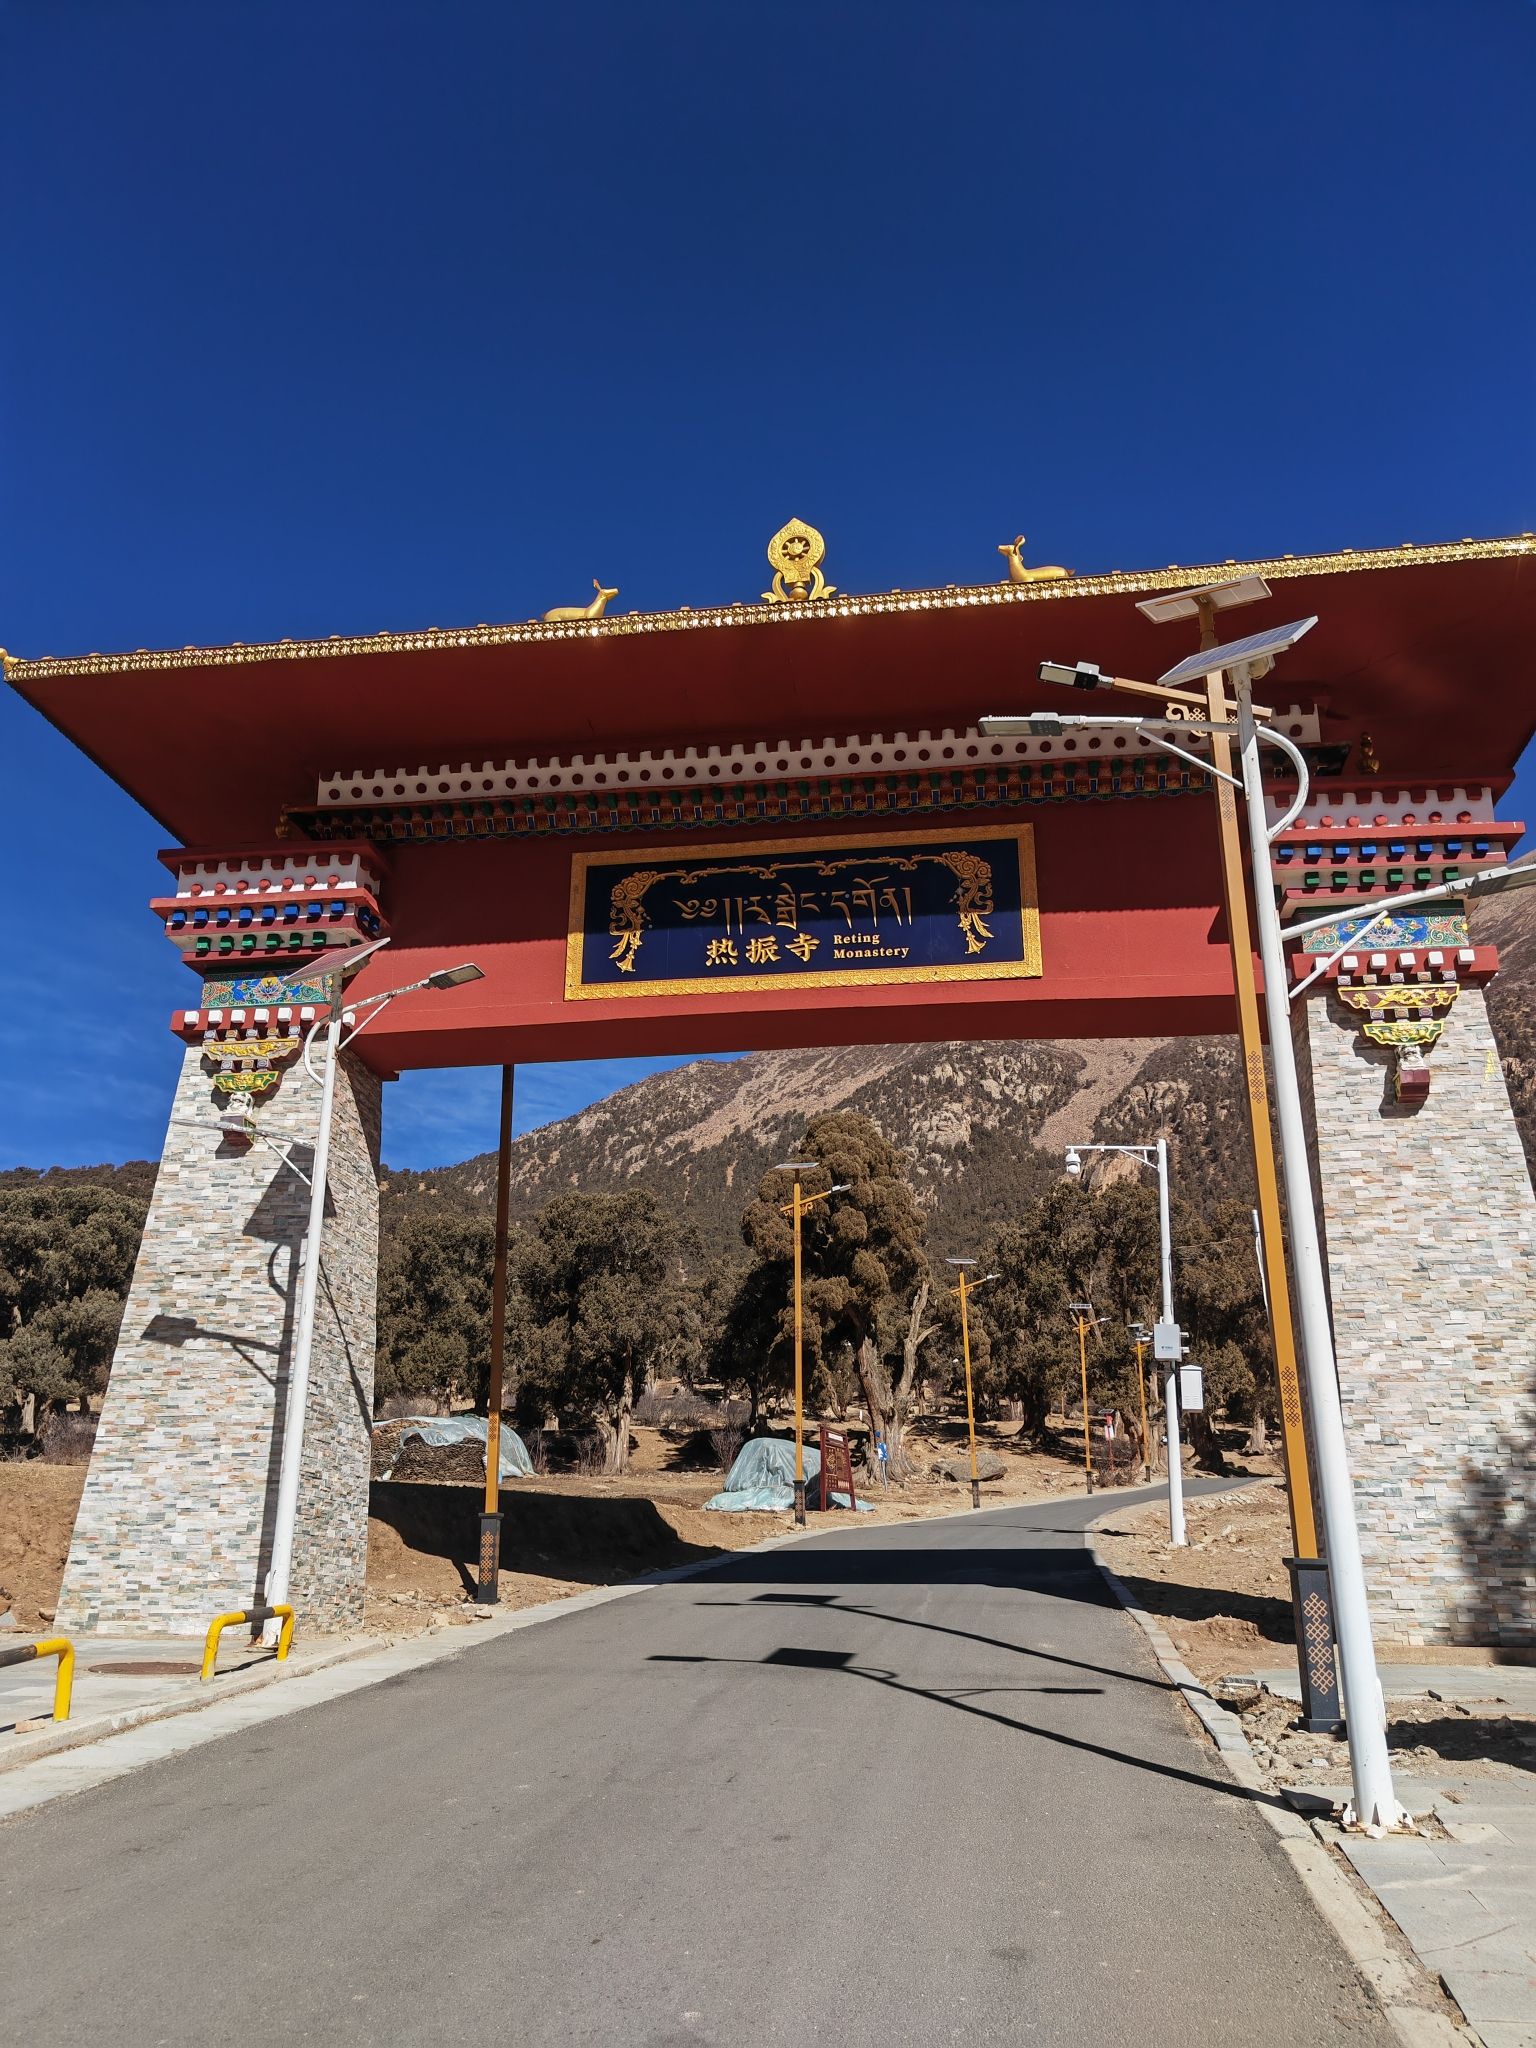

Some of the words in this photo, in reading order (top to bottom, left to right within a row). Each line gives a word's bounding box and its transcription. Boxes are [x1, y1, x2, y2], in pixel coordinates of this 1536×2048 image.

[833, 932, 880, 945] Reting
[705, 933, 821, 967] 热振寺
[833, 947, 910, 960] Monastery
